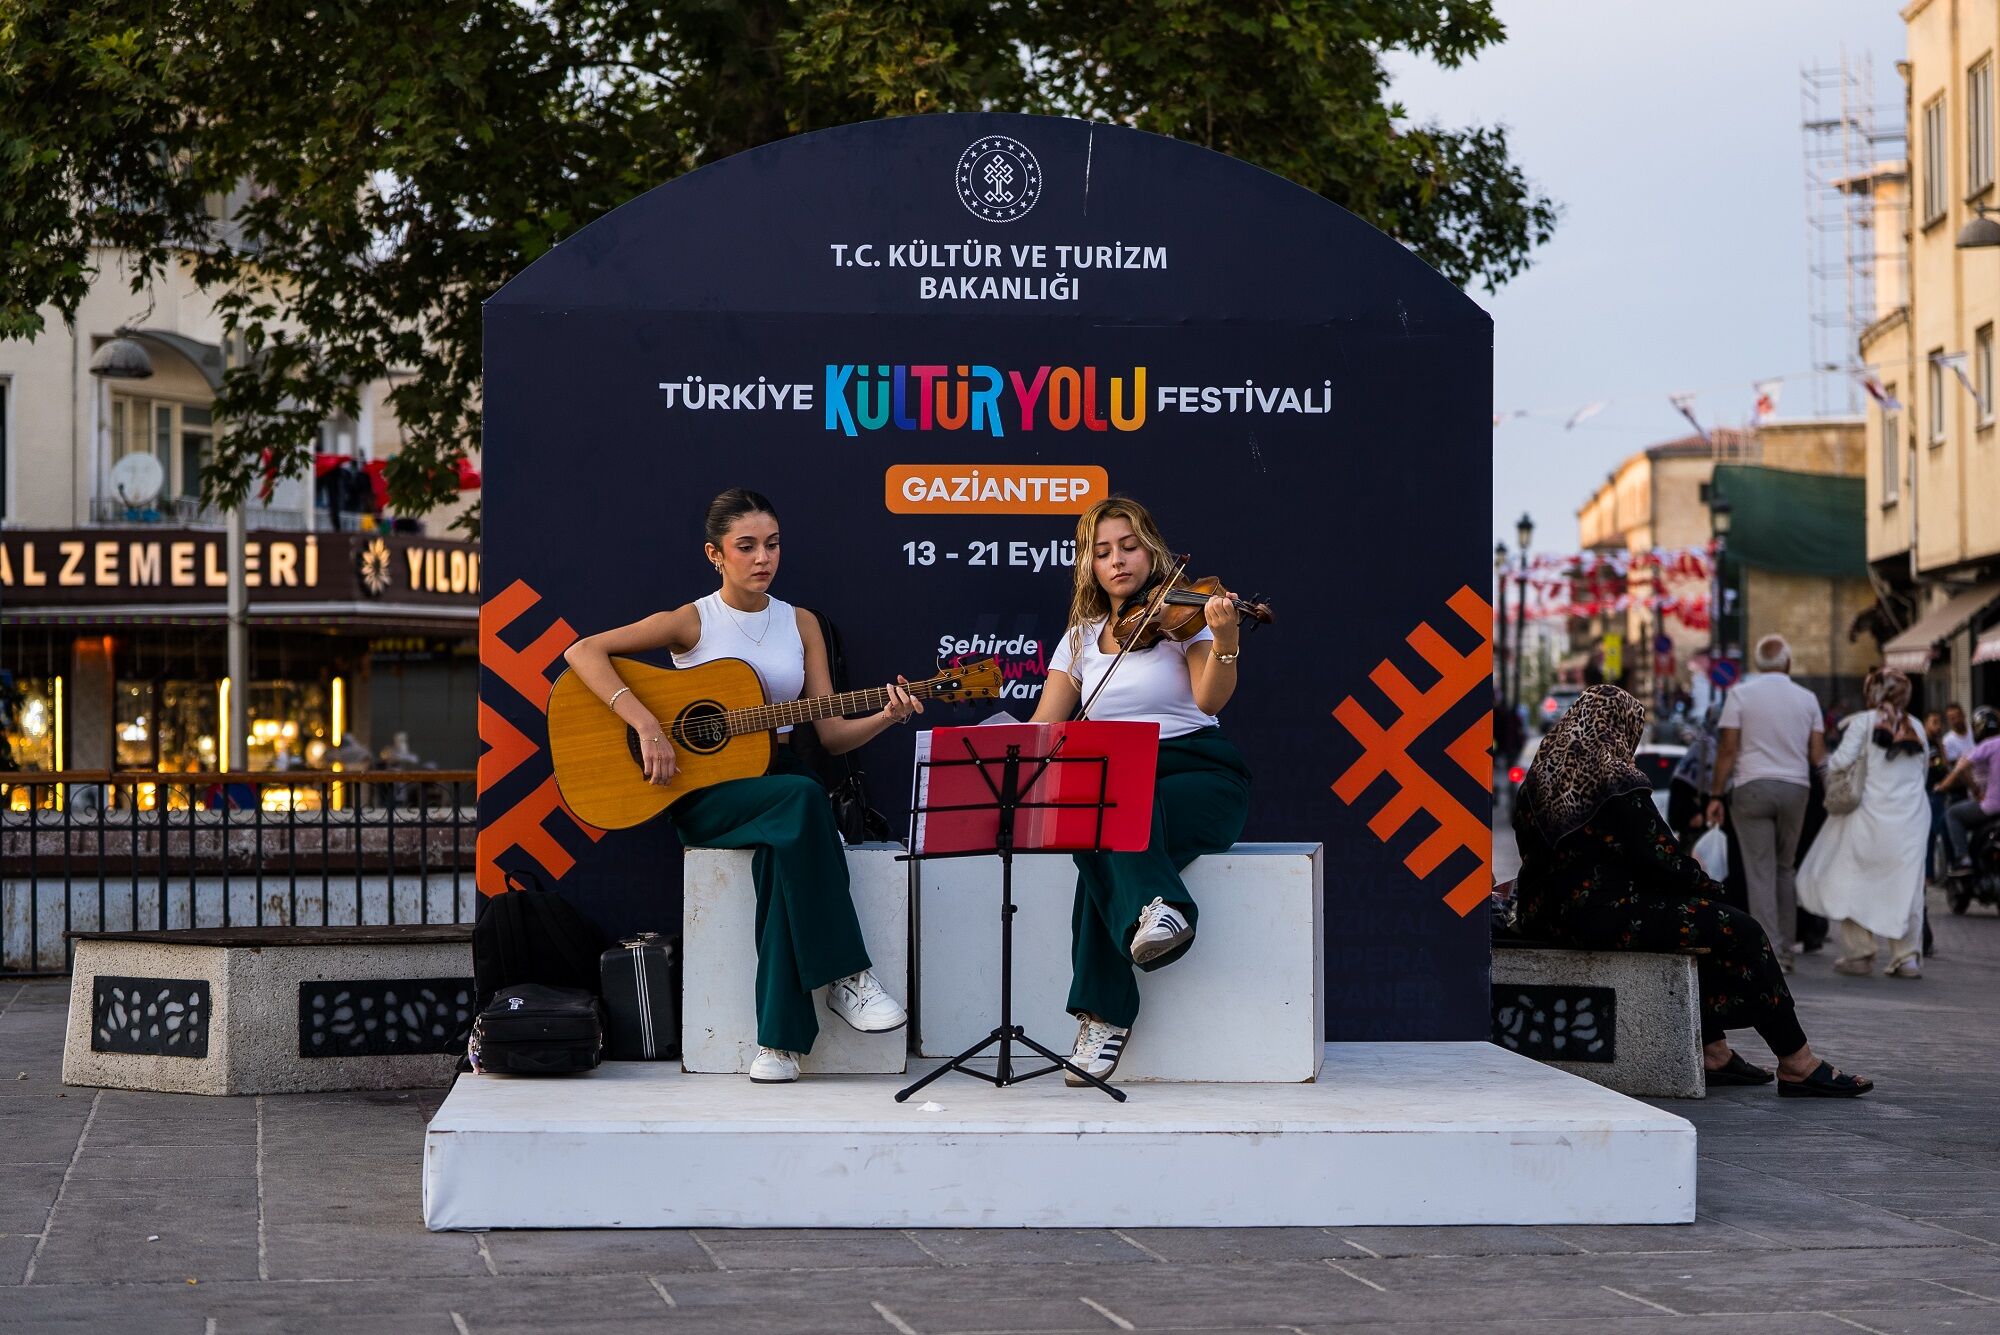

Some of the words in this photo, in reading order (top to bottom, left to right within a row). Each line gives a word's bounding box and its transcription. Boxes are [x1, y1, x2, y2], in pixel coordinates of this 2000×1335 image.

[830, 243, 881, 268] T.C.
[888, 239, 1002, 268] KÜLTÜR
[1010, 244, 1047, 268] VE
[1055, 240, 1168, 270] TURİZM
[919, 272, 1079, 300] BAKANLIĞI
[658, 375, 814, 411] TÜRKİYE
[1157, 379, 1332, 414] FESTİVALİ
[902, 469, 1090, 503] GAZİANTEP
[406, 546, 480, 594] YILDI
[902, 540, 937, 566] 13
[967, 540, 999, 566] 21
[1008, 539, 1076, 573] Eylü
[937, 633, 1039, 659] Şehirde
